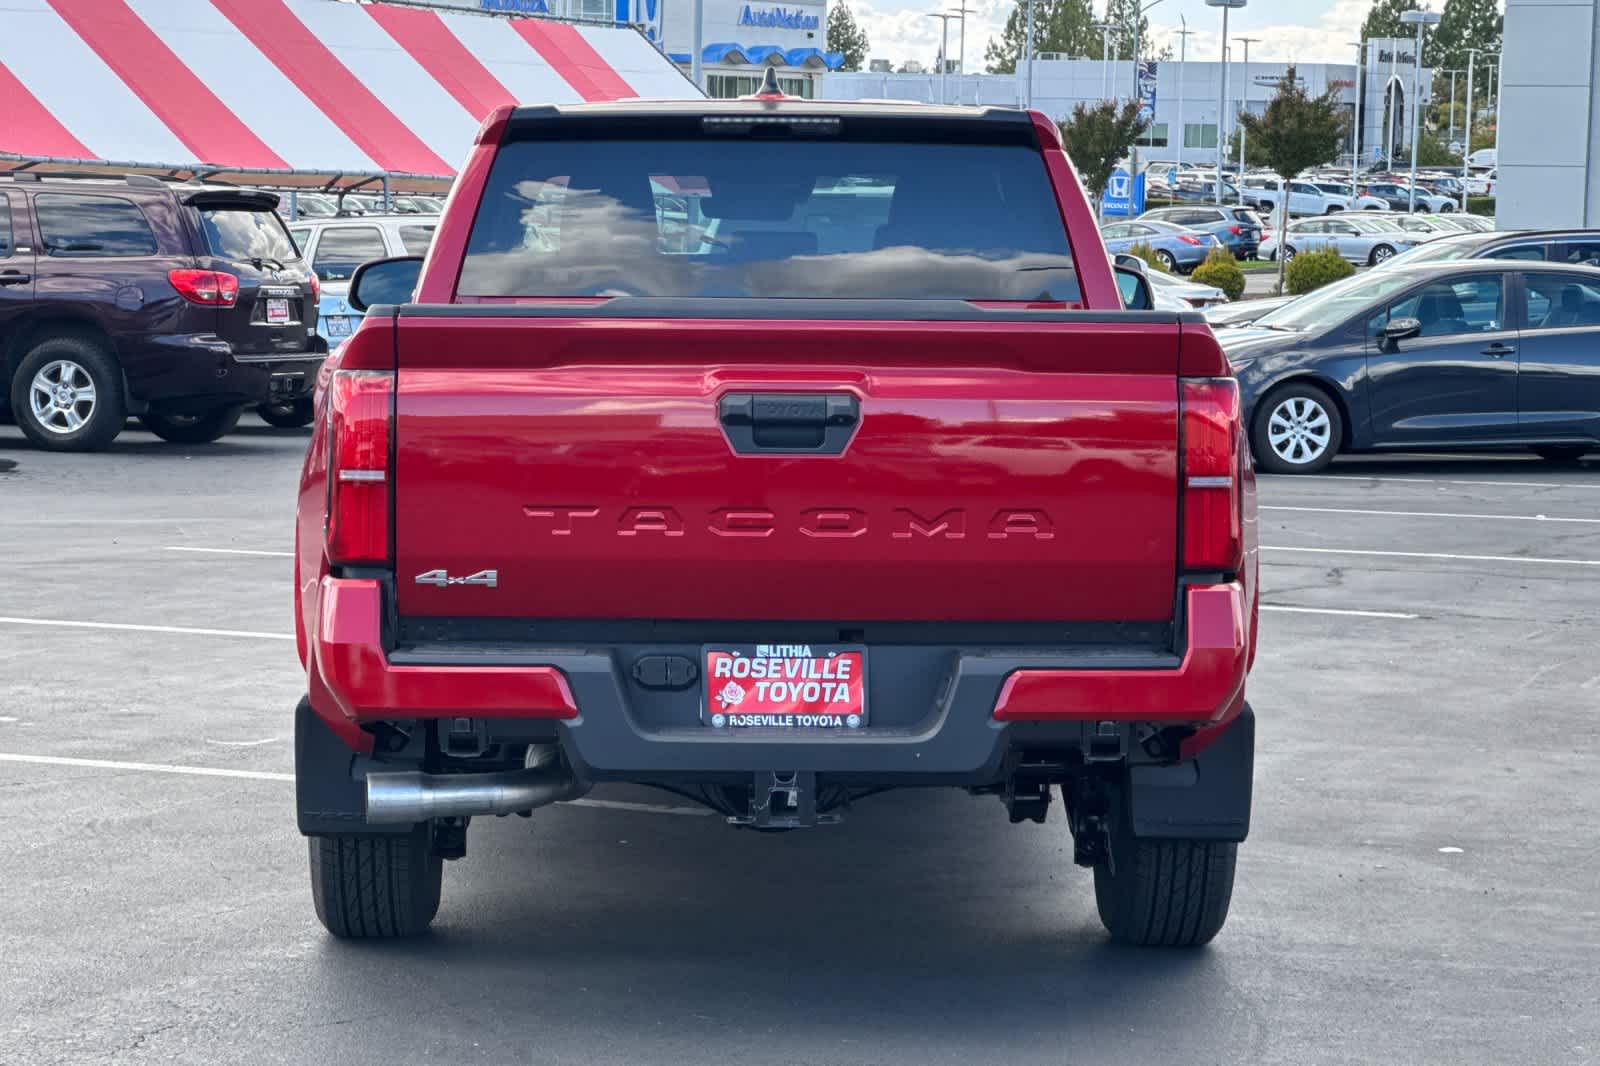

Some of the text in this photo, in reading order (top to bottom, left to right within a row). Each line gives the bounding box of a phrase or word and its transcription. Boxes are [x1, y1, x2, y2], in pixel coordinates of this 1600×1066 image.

[740, 5, 819, 29] AutoNation
[522, 504, 1056, 540] TACOMA
[770, 645, 812, 657] LITHIA
[714, 657, 852, 679] ROSEVILLE
[755, 681, 850, 703] TOYOTA
[729, 715, 842, 726] ROSEVILLE TOYOTA
